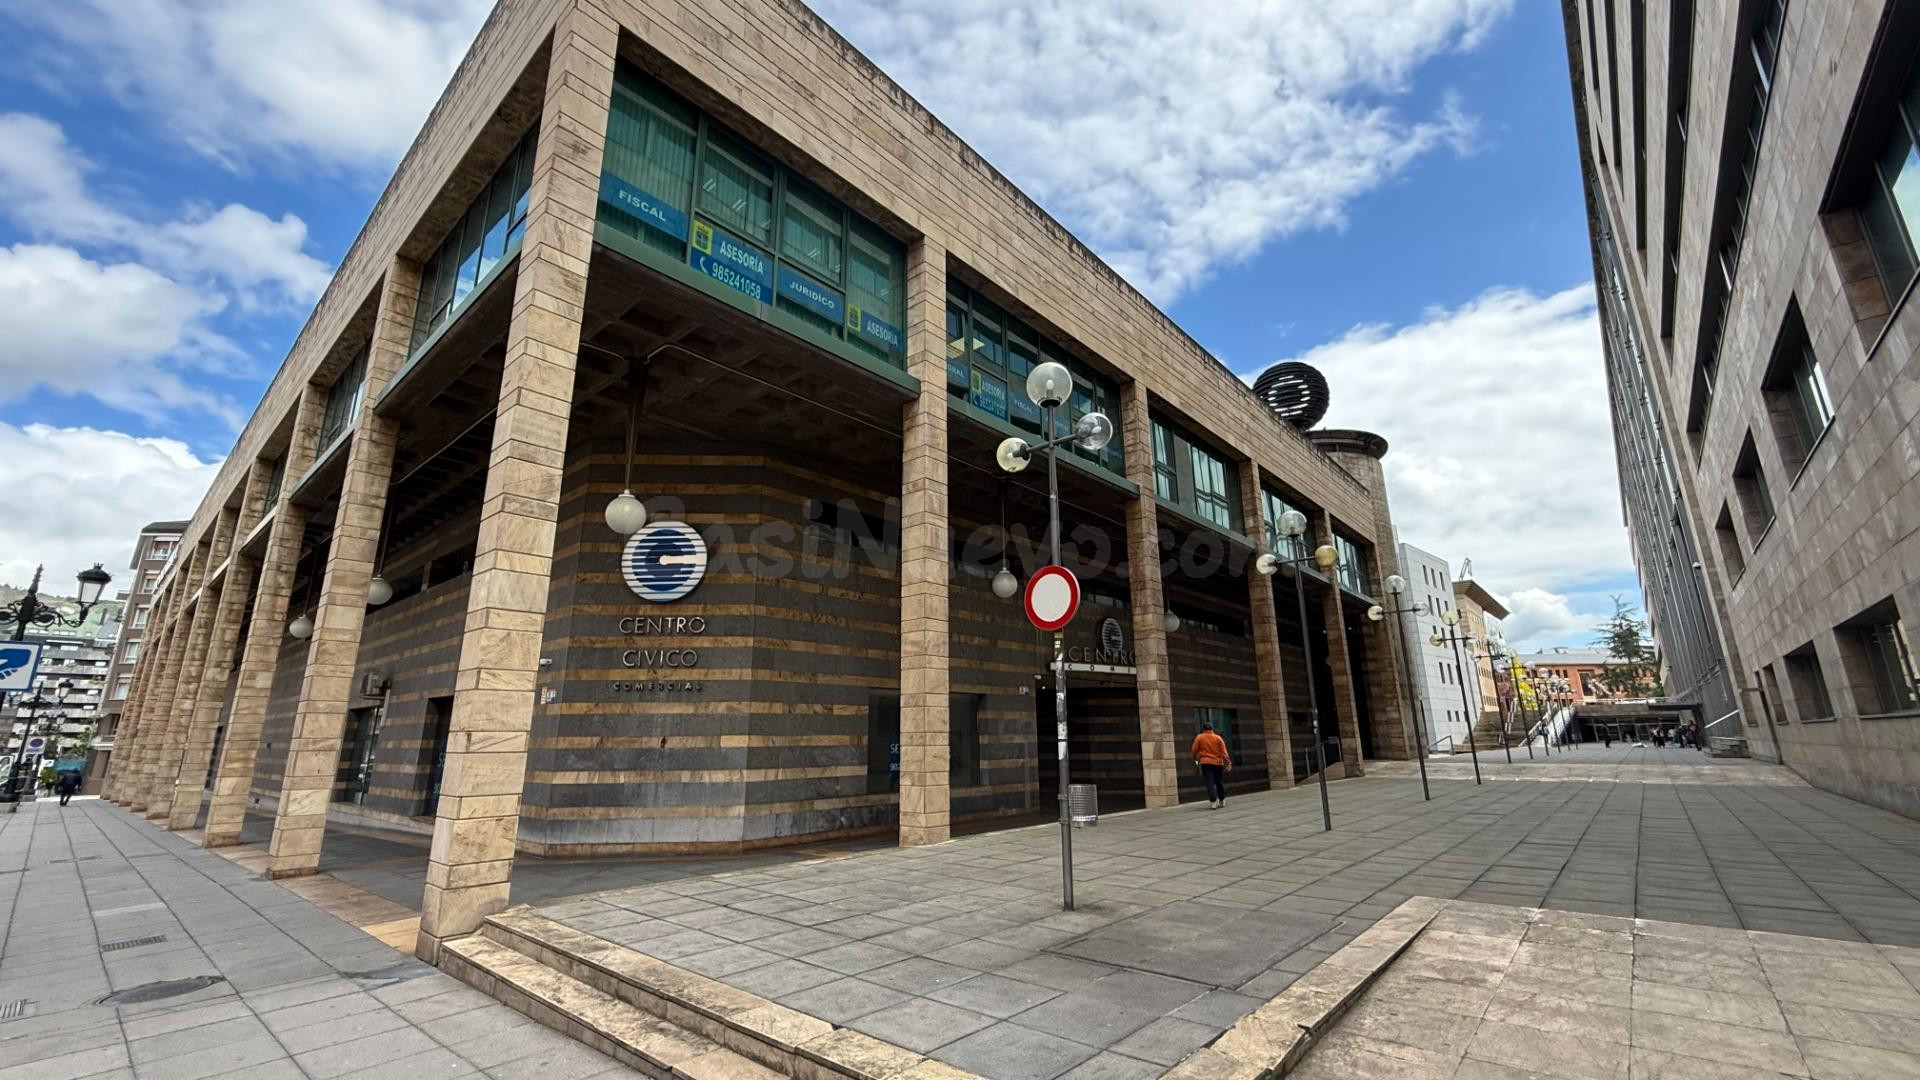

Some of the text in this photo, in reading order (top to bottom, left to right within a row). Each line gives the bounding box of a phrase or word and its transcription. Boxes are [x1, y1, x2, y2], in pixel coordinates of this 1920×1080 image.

[618, 189, 667, 222] FISCAL
[712, 262, 761, 300] 985241058
[618, 616, 706, 634] CENTRO
[622, 649, 698, 668] CIVICO
[613, 681, 704, 692] COMERCIAL
